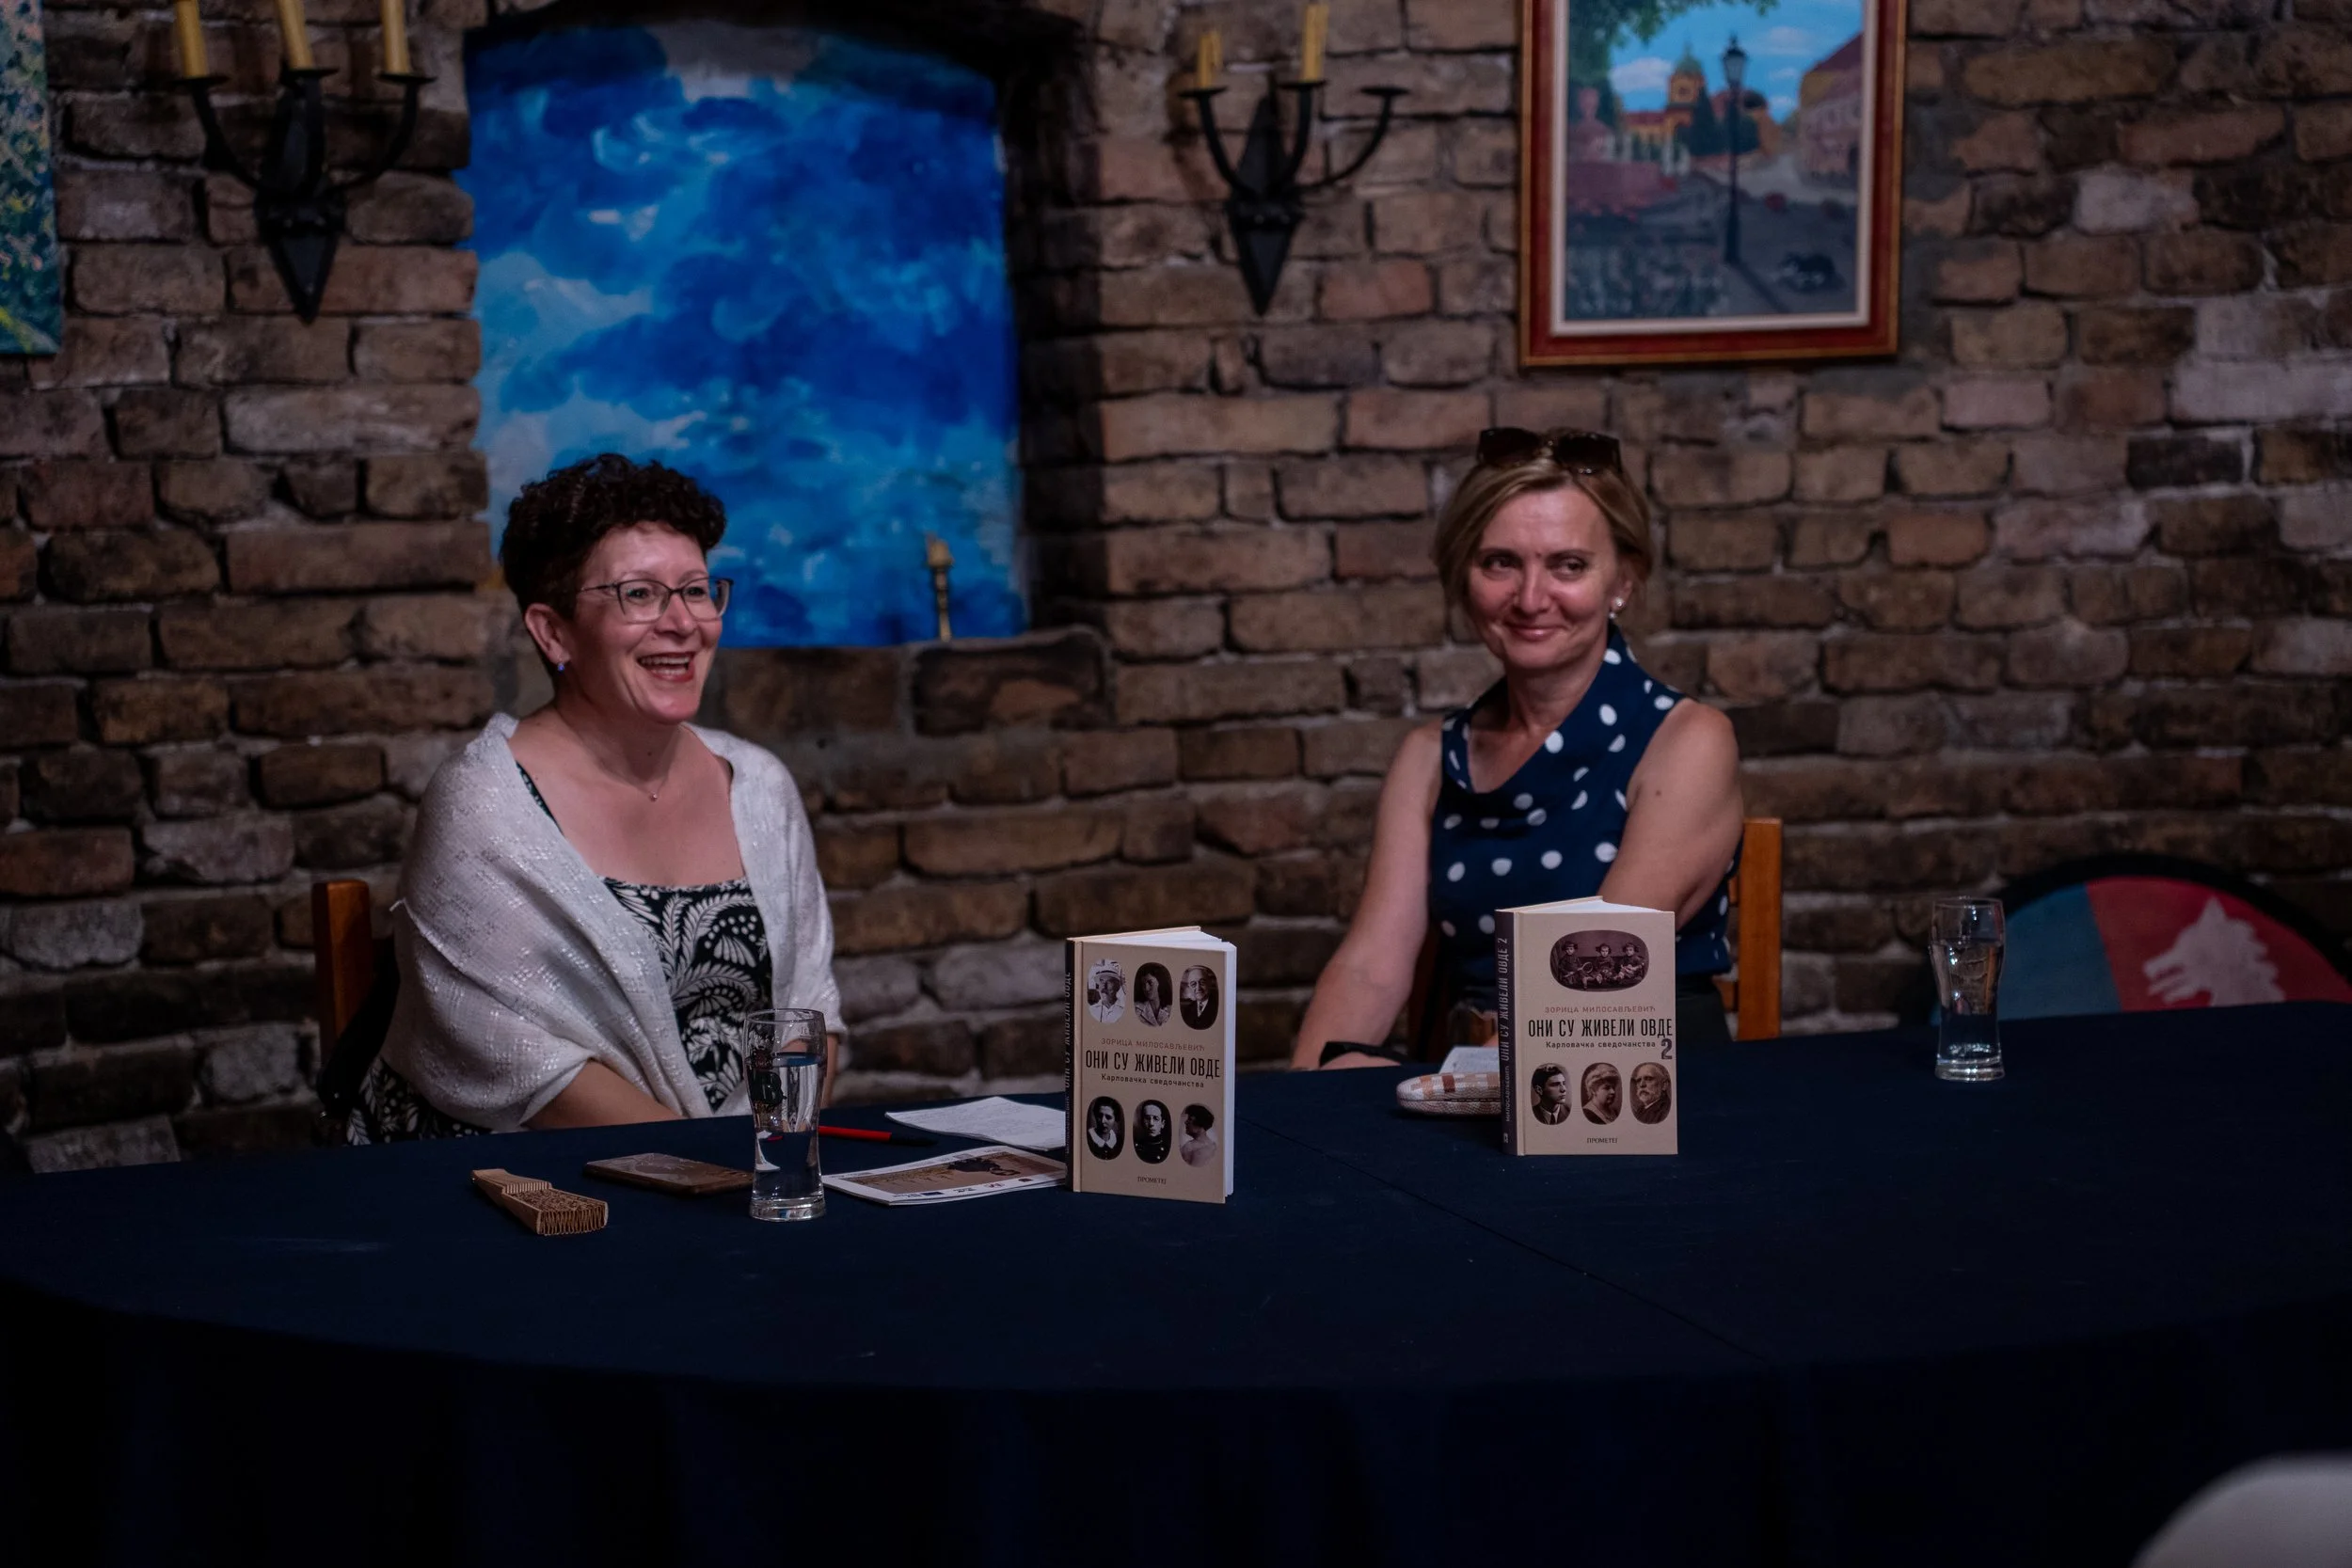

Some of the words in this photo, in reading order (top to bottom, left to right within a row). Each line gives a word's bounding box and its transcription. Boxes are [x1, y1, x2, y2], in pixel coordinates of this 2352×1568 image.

[1497, 948, 1509, 974] ОВДЕ
[1498, 977, 1509, 1020] ЖИВЕЛИ
[1498, 1022, 1509, 1037] СУ
[1528, 1019, 1553, 1037] ОНИ
[1559, 1019, 1575, 1037] СУ
[1581, 1019, 1634, 1037] ЖИВЕЛИ
[1641, 1018, 1673, 1038] ОВДЕ
[1101, 1037, 1133, 1046] ЗОРИЦА
[1136, 1040, 1205, 1052] МИЛОСАВЉЕВИЋ
[1661, 1037, 1673, 1060] 2
[1086, 1050, 1108, 1069] ОНИ
[1114, 1052, 1129, 1070] СУ
[1135, 1053, 1184, 1075] ЖИВЕЛИ
[1190, 1057, 1220, 1080] ОВДЕ
[1101, 1073, 1147, 1084] Карловачка
[1150, 1078, 1204, 1088] сведочанства
